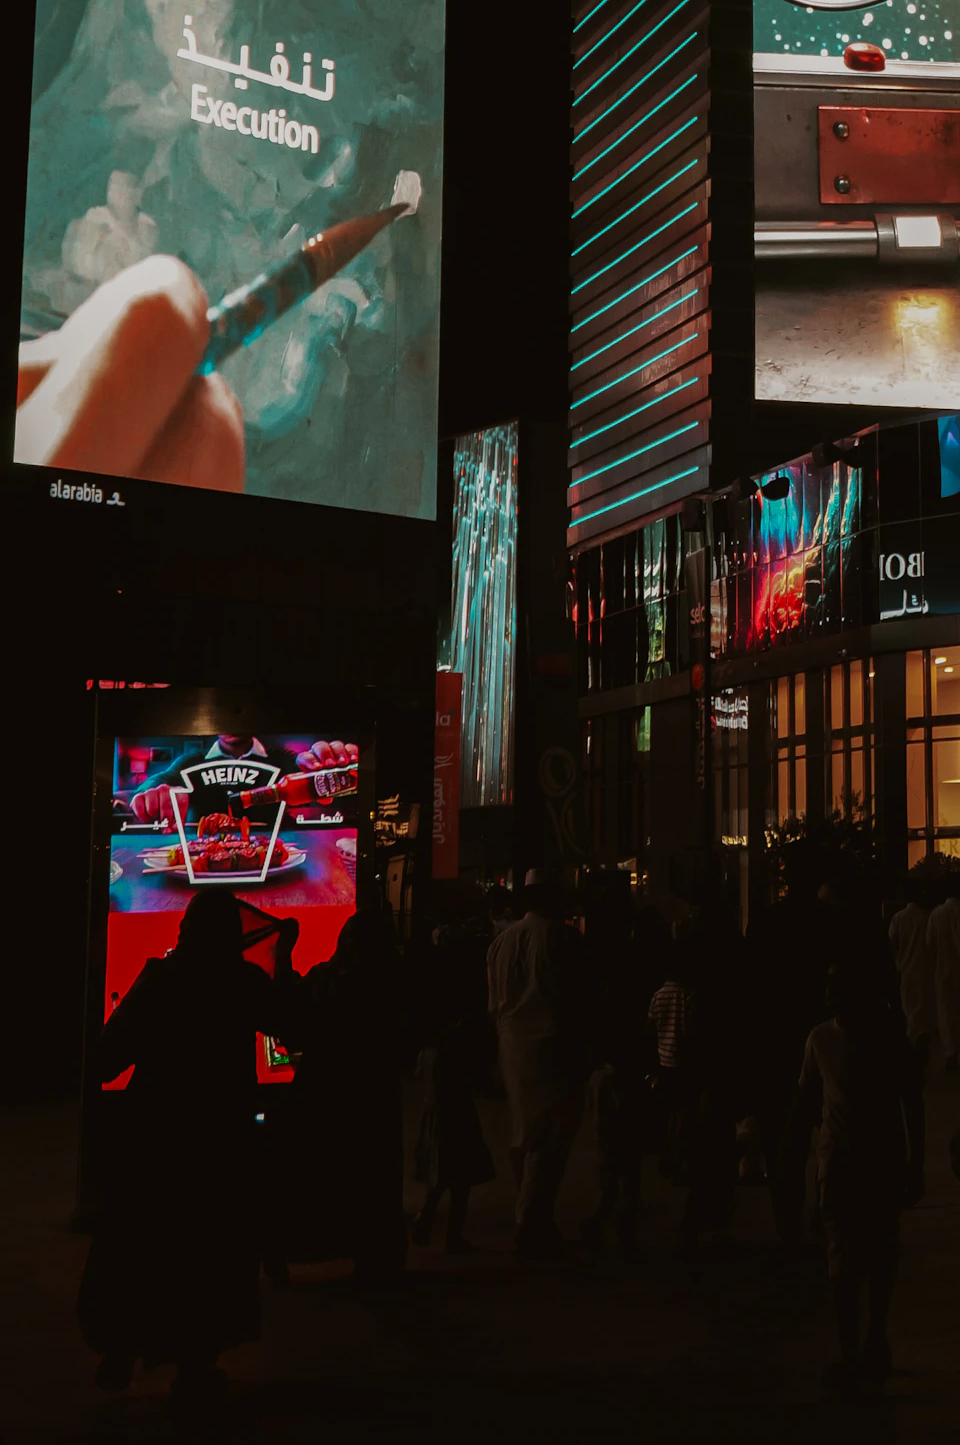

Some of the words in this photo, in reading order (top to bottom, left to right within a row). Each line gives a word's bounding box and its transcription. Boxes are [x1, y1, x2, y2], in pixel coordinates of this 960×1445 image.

[177, 15, 335, 101] تنفيذ
[191, 83, 319, 154] Execution
[50, 479, 103, 504] alarabia
[201, 767, 259, 785] HEINZ
[120, 817, 170, 832] غير
[296, 811, 344, 825] شطة
